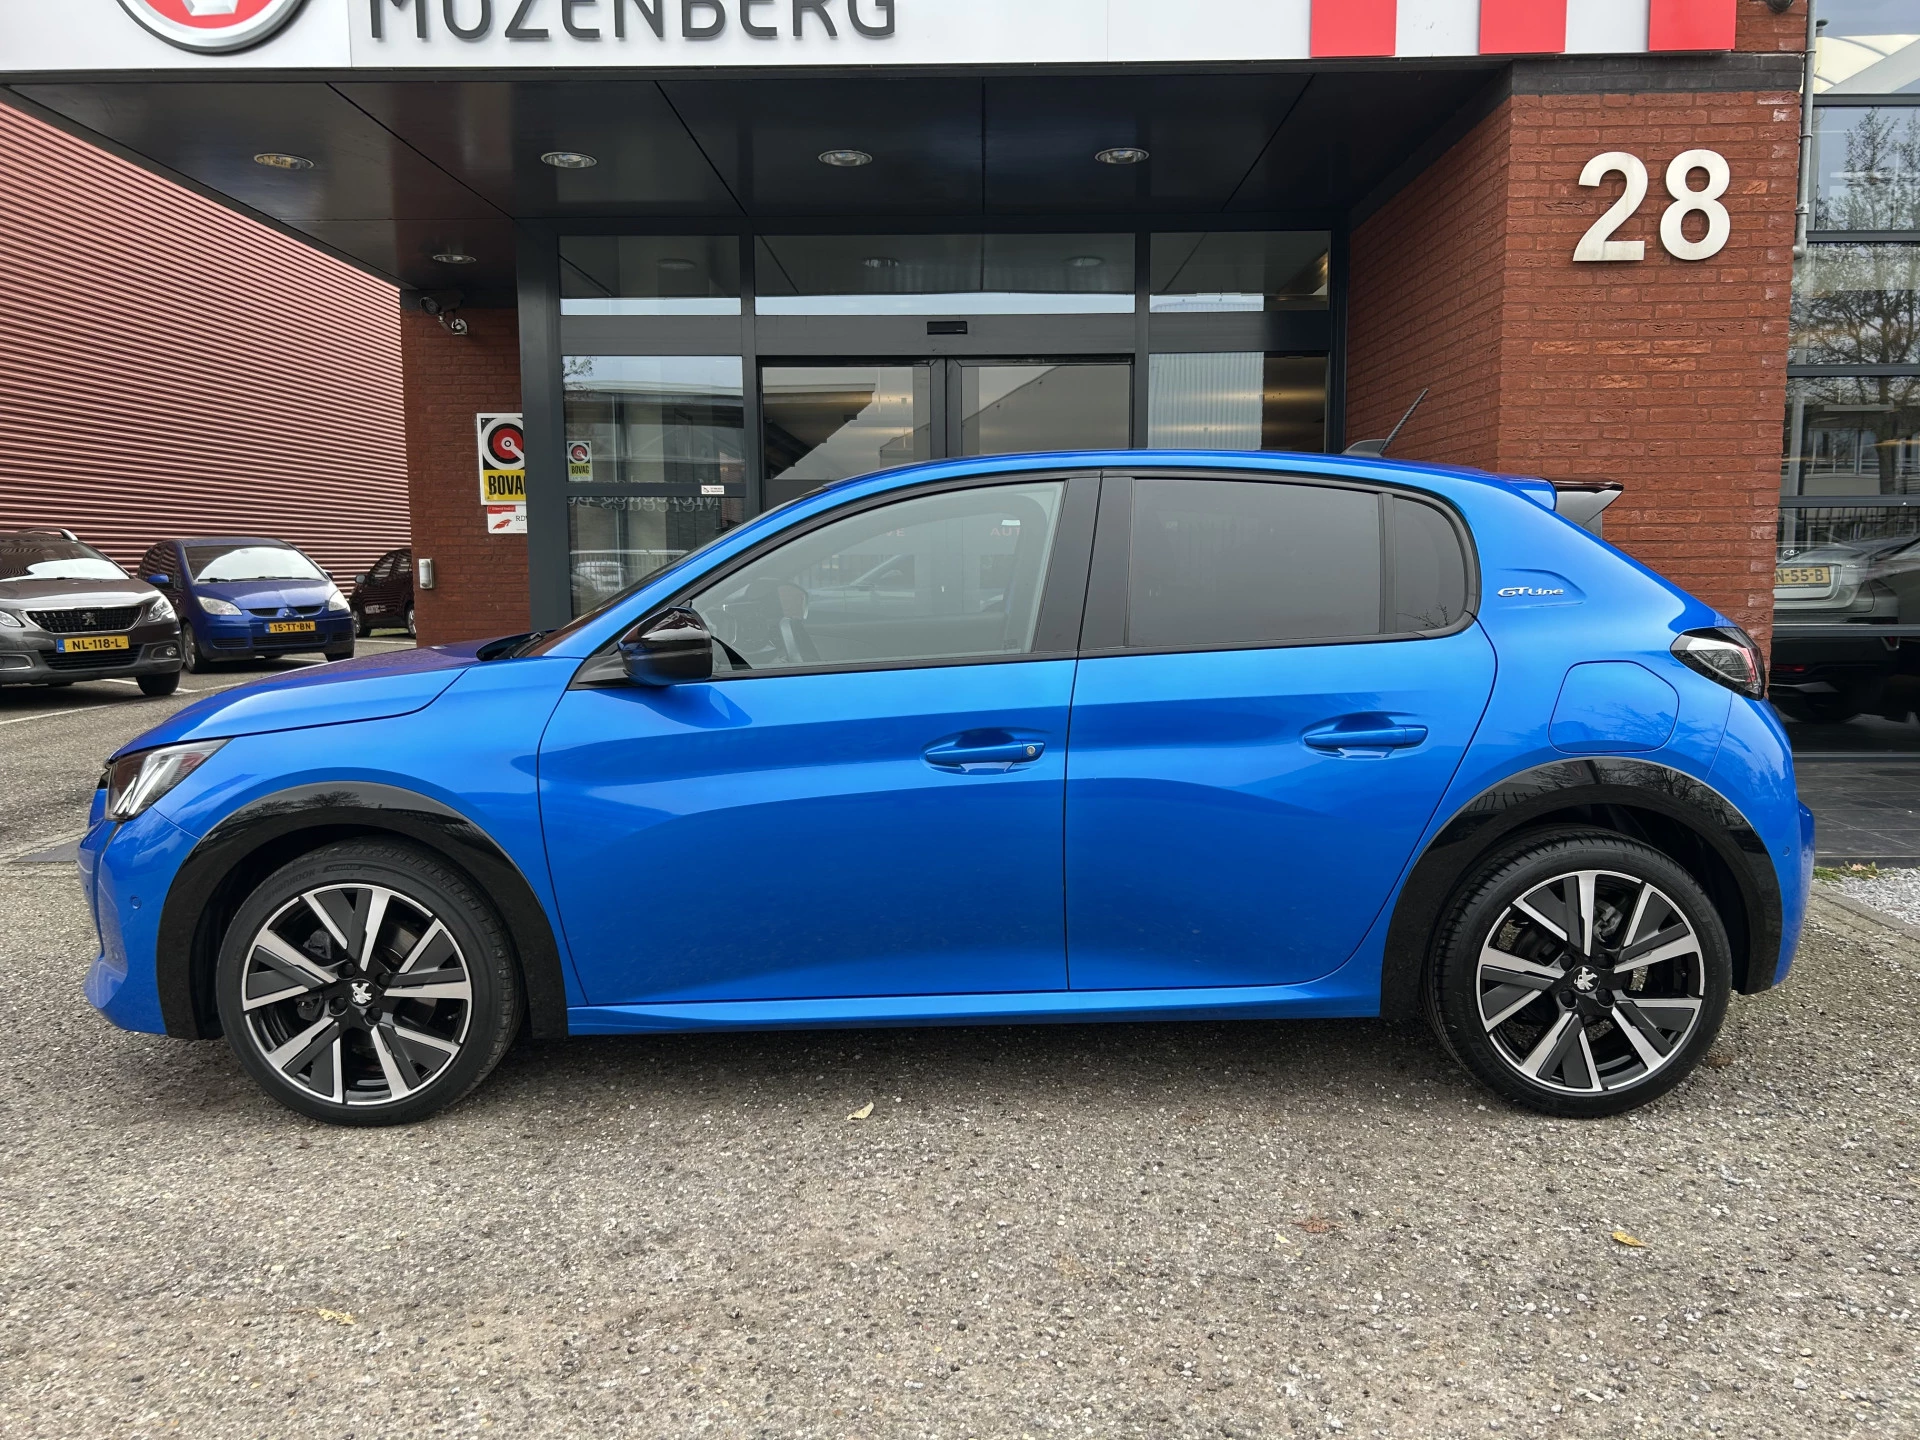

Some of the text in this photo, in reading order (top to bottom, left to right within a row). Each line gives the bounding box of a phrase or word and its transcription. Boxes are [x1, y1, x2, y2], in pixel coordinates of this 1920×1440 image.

[1572, 149, 1731, 262] 28
[571, 465, 590, 474] BOVAG
[488, 475, 526, 495] BOVA
[273, 622, 311, 632] 15-TT-BN
[72, 638, 122, 650] NL-118-L
